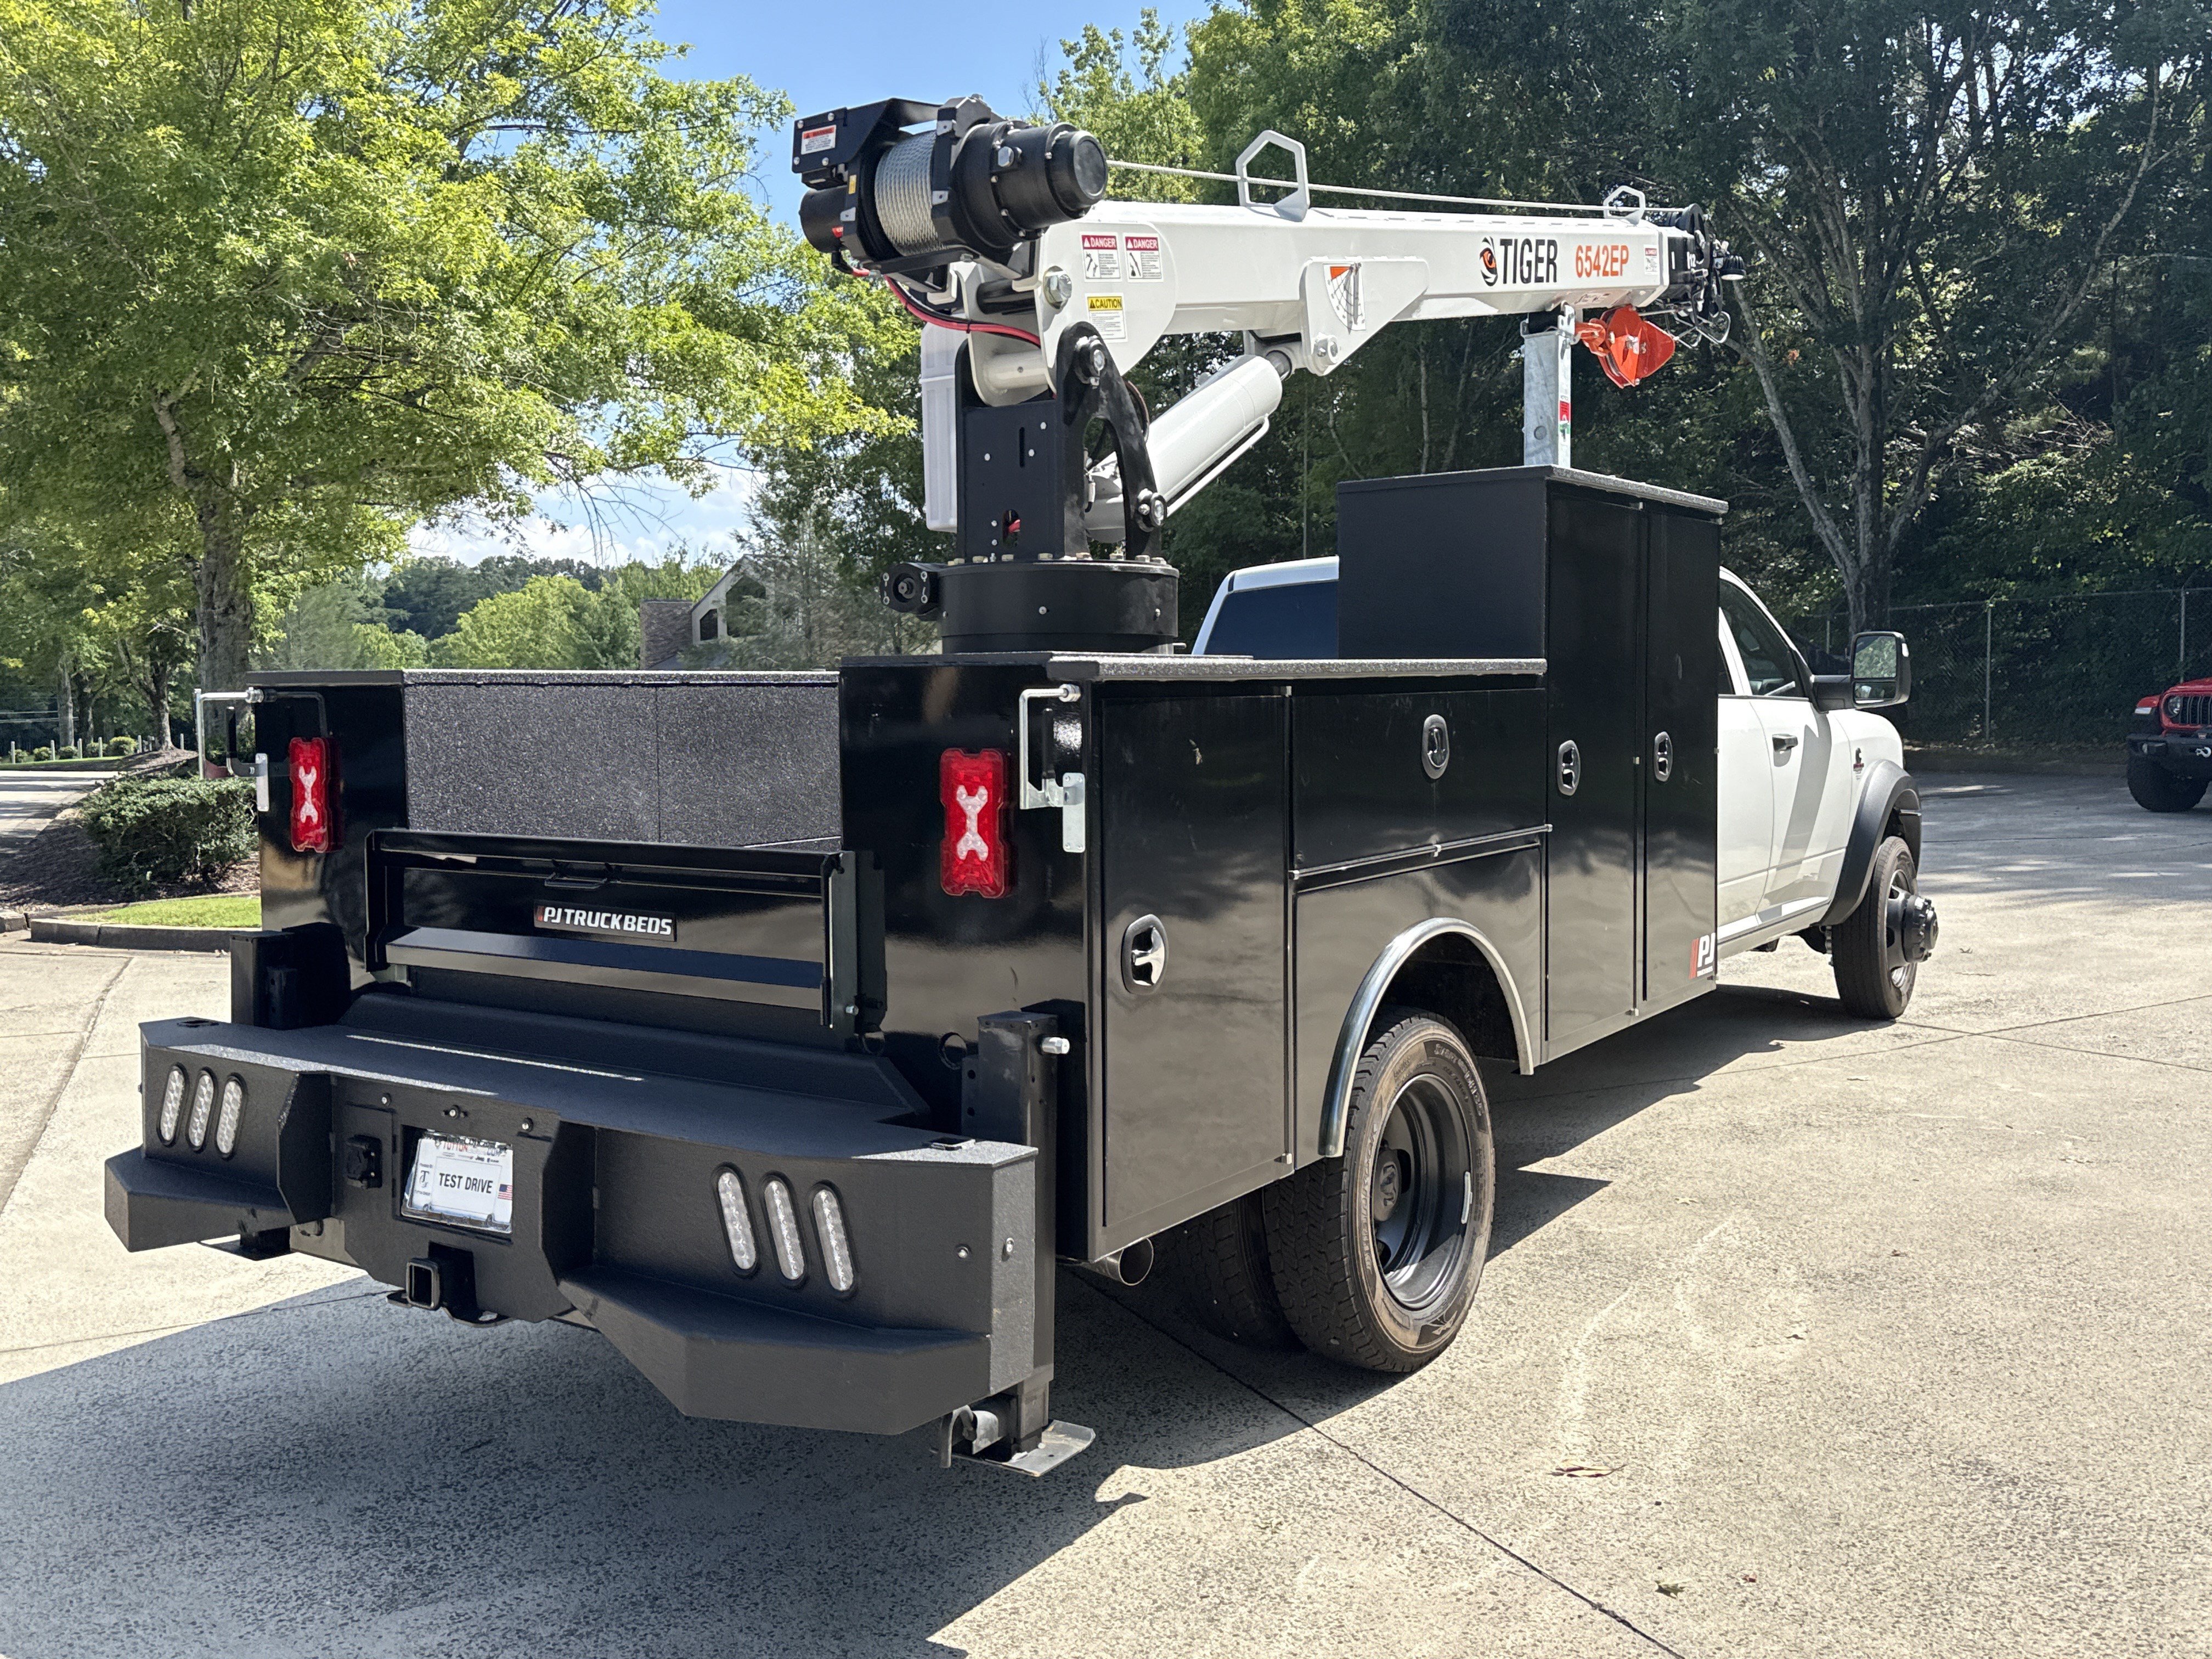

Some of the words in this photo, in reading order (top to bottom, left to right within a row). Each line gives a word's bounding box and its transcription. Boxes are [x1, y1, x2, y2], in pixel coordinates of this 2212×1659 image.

[1090, 237, 1116, 248] DANGER
[1133, 239, 1159, 249] DANGER
[1499, 238, 1558, 284] TIGER
[1576, 245, 1629, 278] 6542EP
[1095, 298, 1123, 309] CAUTION
[1697, 933, 1716, 968] PJ
[439, 1172, 463, 1189] TEST
[465, 1176, 493, 1193] DRIVE
